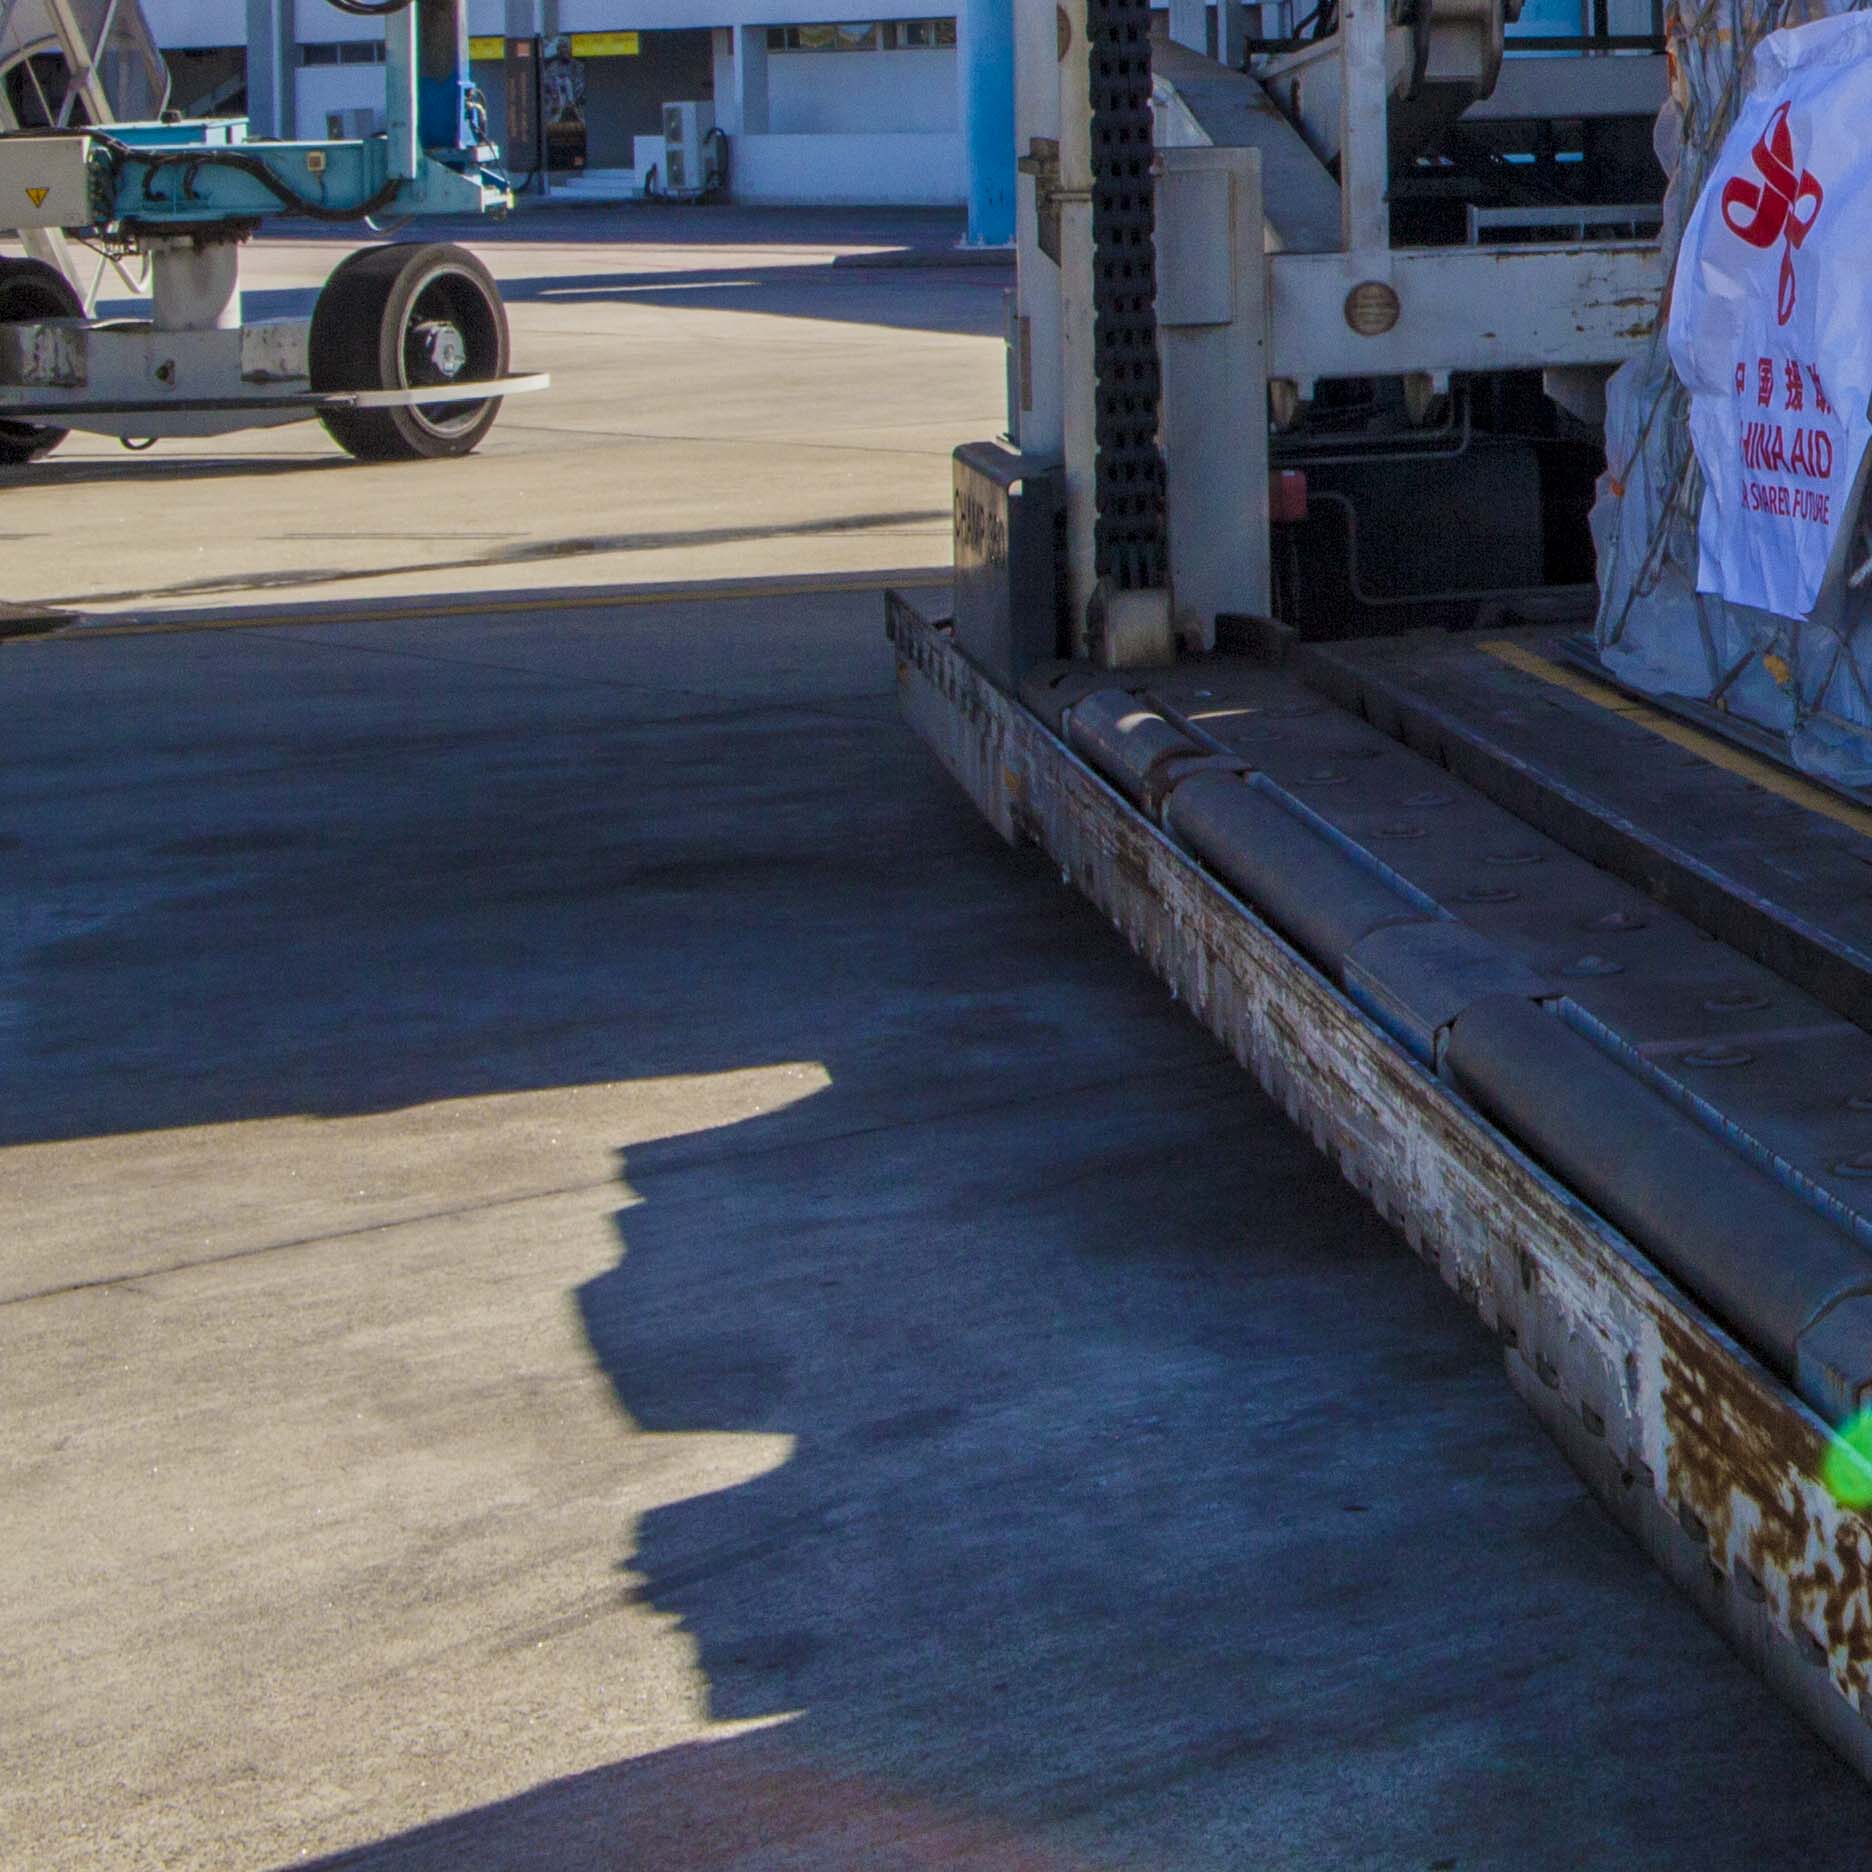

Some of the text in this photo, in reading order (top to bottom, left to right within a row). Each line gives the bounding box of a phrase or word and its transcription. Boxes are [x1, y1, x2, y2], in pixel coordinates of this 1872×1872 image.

[1740, 421, 1833, 479] HINA AID
[1792, 488, 1830, 526] FUTURE
